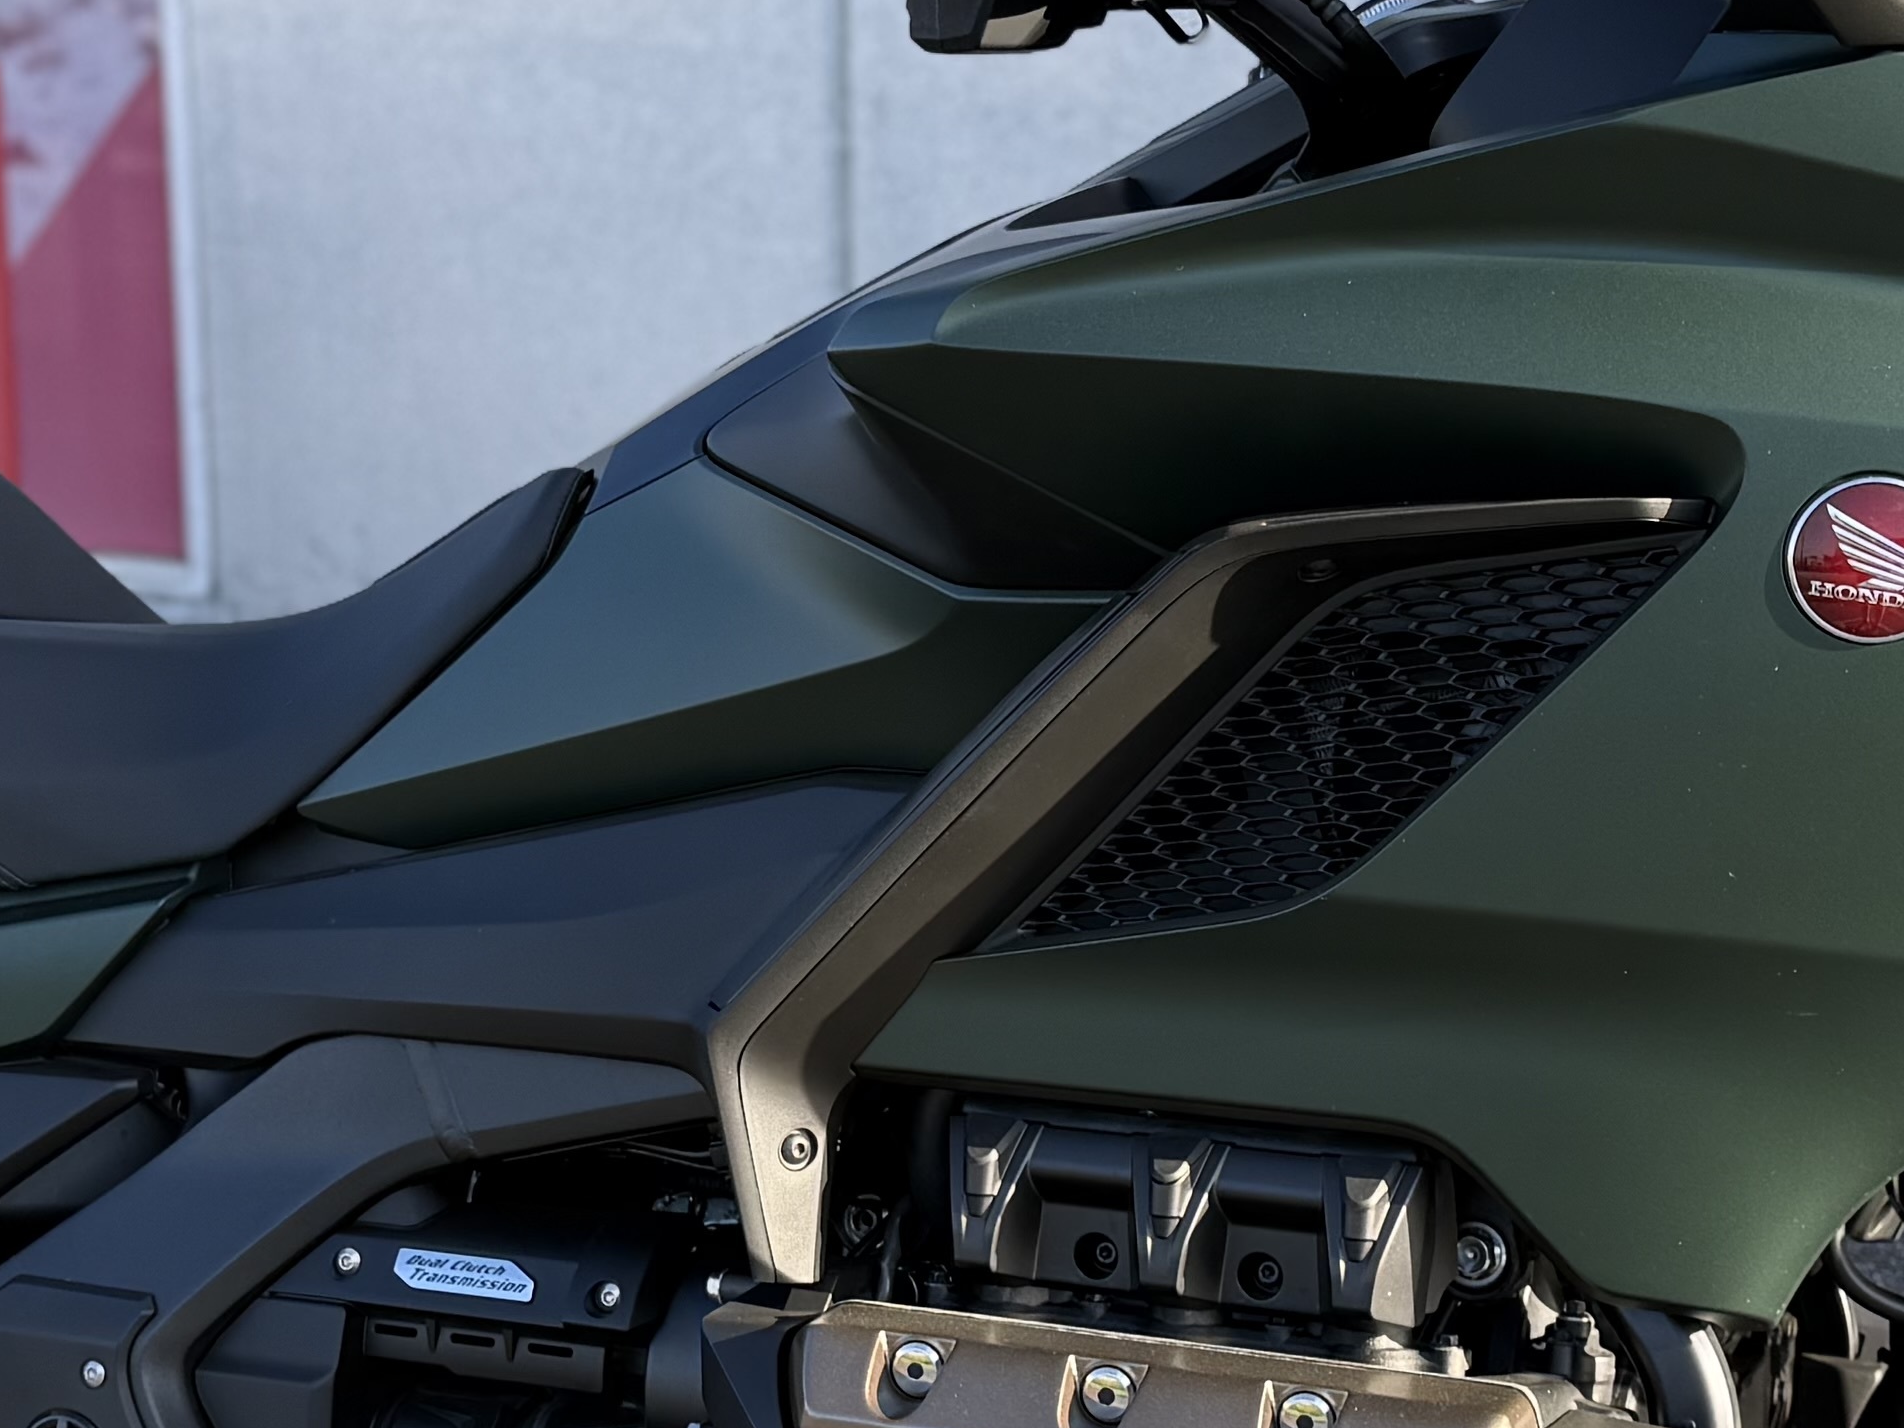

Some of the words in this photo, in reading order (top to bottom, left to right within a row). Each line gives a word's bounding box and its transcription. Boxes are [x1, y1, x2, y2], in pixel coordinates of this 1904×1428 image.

[406, 1254, 449, 1269] Dual
[449, 1259, 507, 1276] Clutch
[409, 1266, 528, 1293] Transmission
